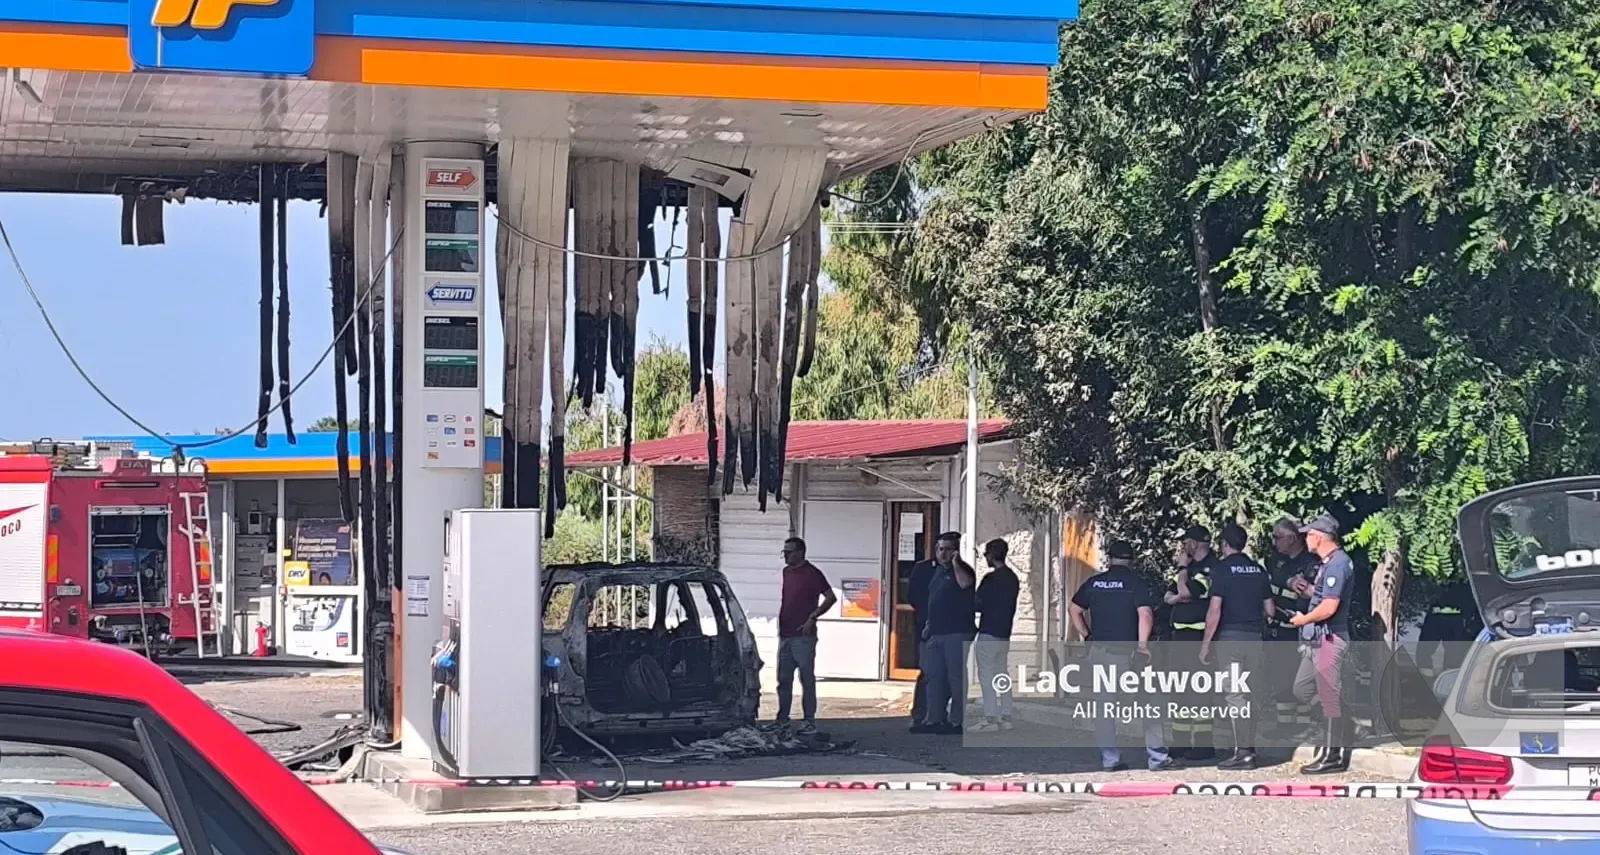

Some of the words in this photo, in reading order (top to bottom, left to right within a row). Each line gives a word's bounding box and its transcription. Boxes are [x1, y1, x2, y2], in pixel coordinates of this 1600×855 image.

[436, 172, 462, 183] SELF
[431, 288, 472, 299] SERVITO
[1230, 565, 1262, 573] POLIZIA
[288, 570, 306, 578] DKV
[1093, 580, 1124, 589] POLIZIA
